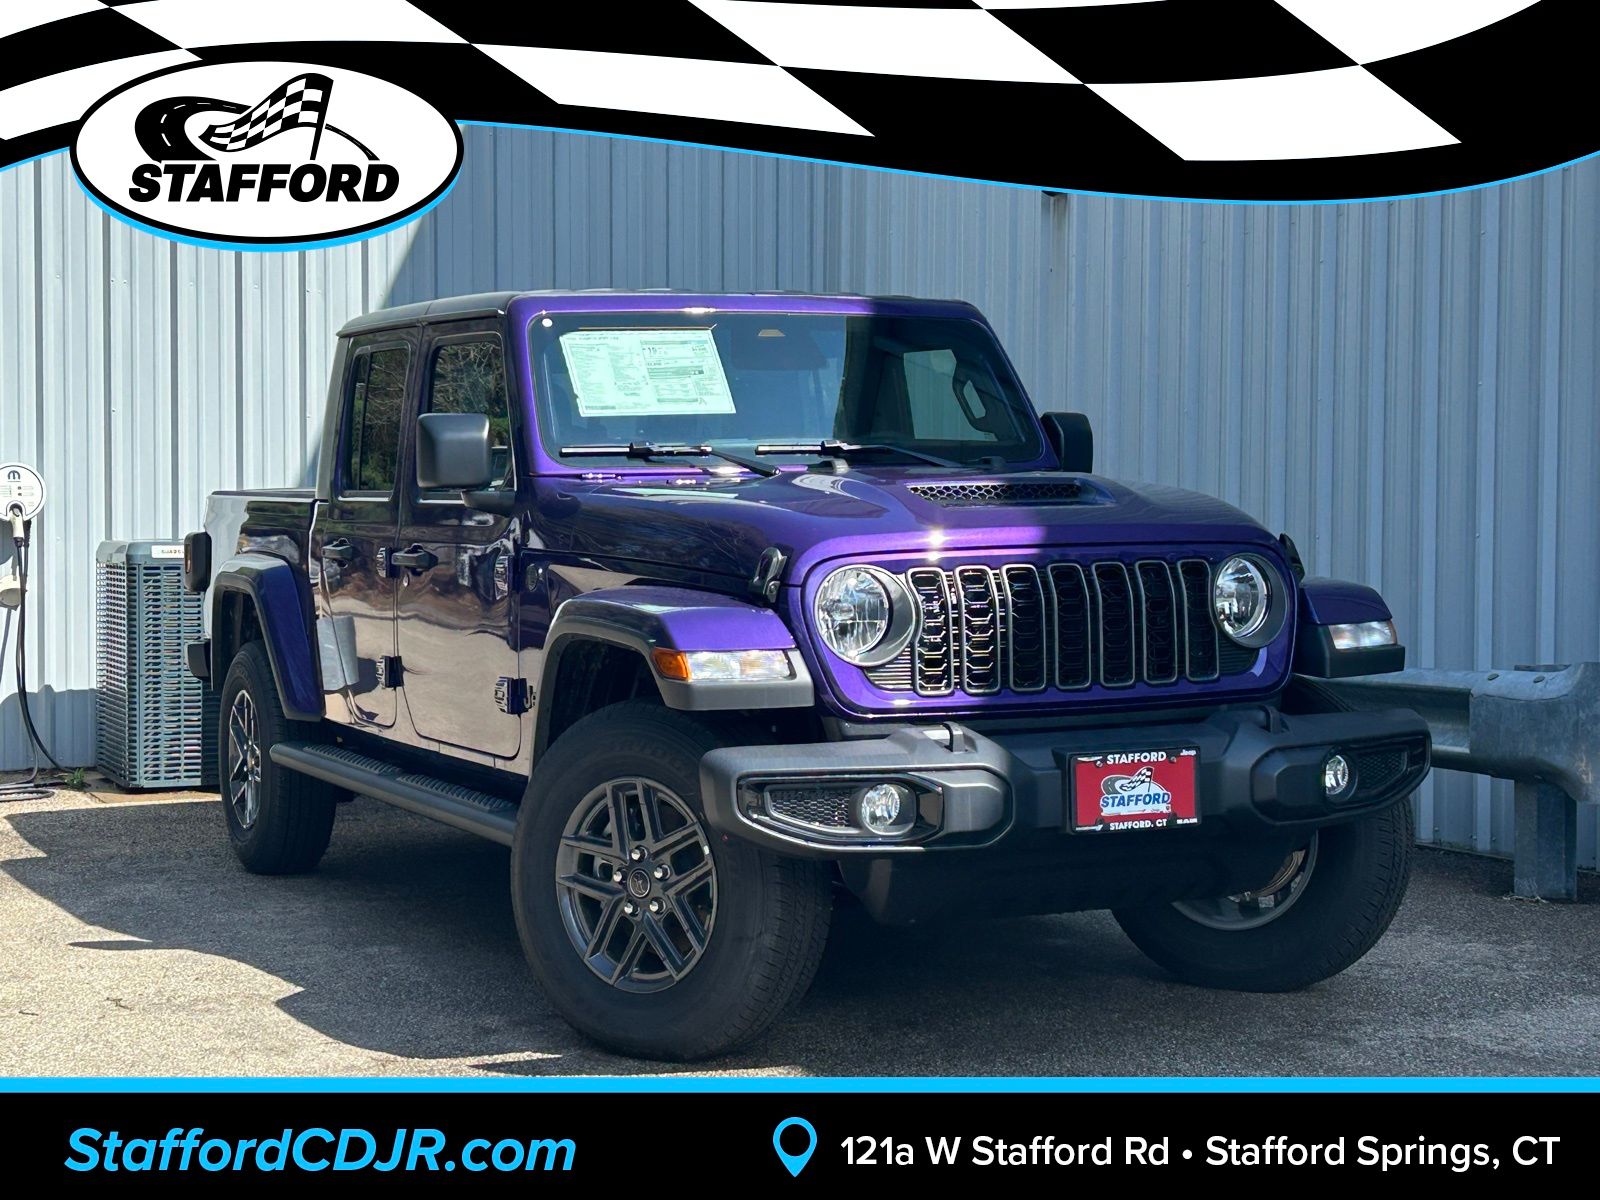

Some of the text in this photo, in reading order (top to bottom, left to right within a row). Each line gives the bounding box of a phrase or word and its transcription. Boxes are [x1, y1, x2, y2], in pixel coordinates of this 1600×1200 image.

[1106, 751, 1167, 765] STAFFORD
[1101, 792, 1171, 808] STAFFORD
[1156, 819, 1168, 828] CT
